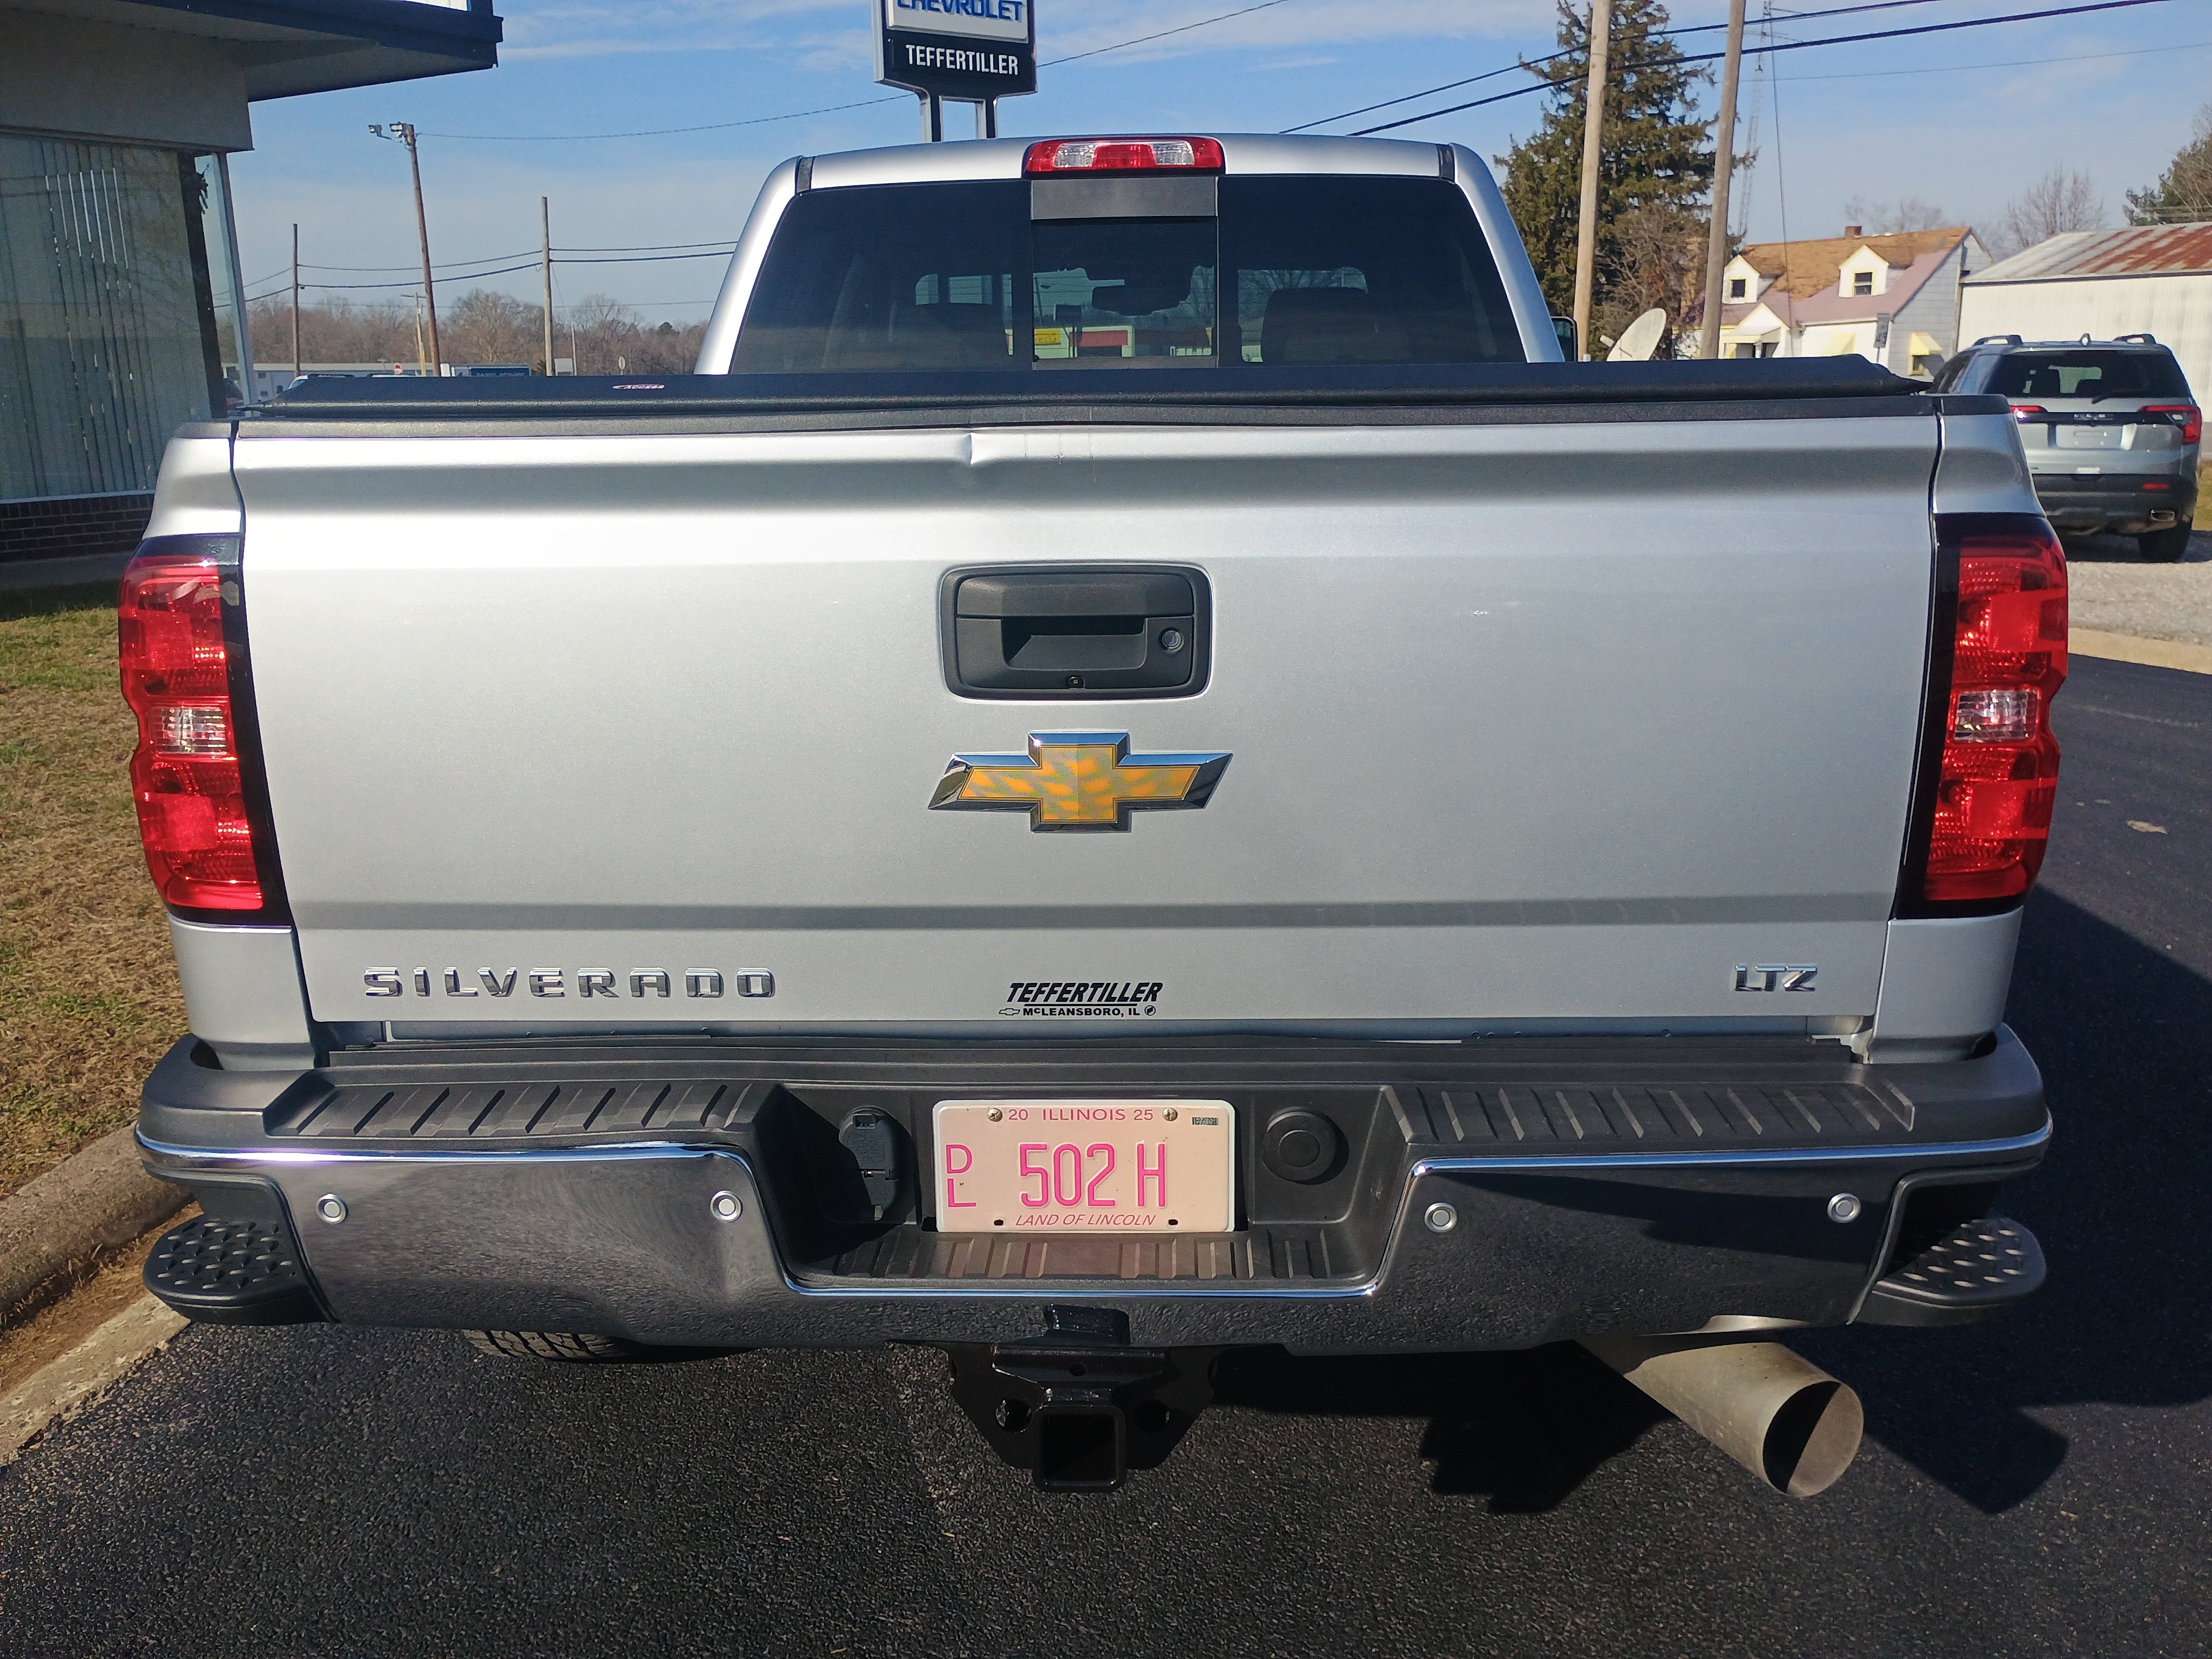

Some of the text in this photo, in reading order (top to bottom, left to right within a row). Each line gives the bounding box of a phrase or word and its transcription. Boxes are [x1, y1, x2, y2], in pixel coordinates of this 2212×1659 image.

[905, 44, 1018, 76] TEFFERTILLER
[363, 966, 777, 998] SILVERADO
[1735, 964, 1818, 992] LTZ
[1007, 982, 1163, 1002] TEFFERTILLER
[1128, 1008, 1141, 1016] IL
[1008, 1109, 1154, 1121] 20 ILLINOIS 25
[1020, 1143, 1166, 1207] 502 H
[1015, 1215, 1157, 1226] LAND OF LINCOLN
